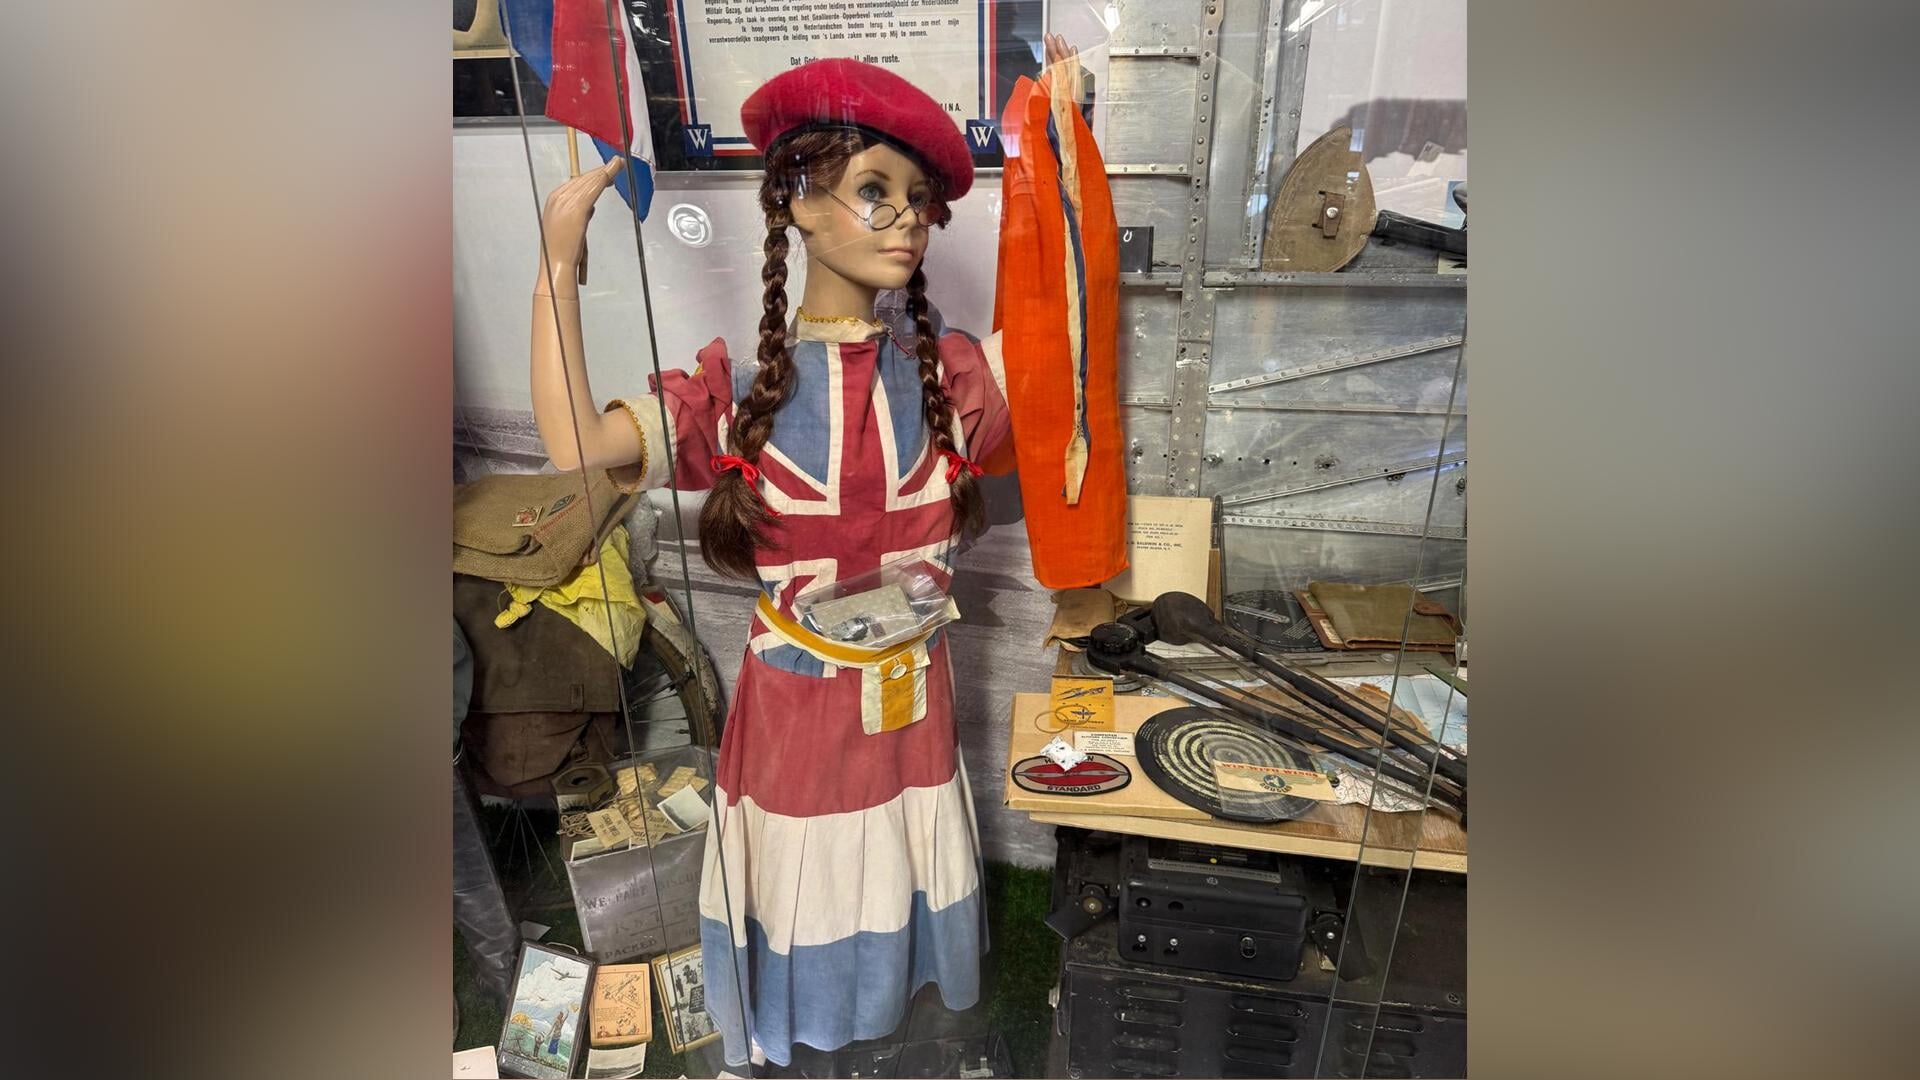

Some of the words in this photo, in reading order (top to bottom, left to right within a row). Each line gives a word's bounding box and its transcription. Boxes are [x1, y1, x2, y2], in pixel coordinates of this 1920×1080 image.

[791, 4, 812, 12] regeling
[829, 2, 846, 10] leiding
[751, 25, 764, 33] hoop
[768, 24, 788, 33] spoedig
[869, 20, 883, 29] terug
[791, 33, 809, 42] leiding
[829, 32, 845, 40] Lands
[880, 31, 887, 39] op
[889, 30, 898, 39] Mij
[790, 56, 801, 66] Dat
[862, 54, 879, 64] allen
[881, 53, 901, 63] ruste.
[687, 128, 709, 150] W
[969, 126, 994, 147] W
[1249, 765, 1279, 773] WITH
[1283, 769, 1318, 777] WINGS
[1047, 784, 1101, 792] STANDARD
[605, 938, 657, 959] PACKED
